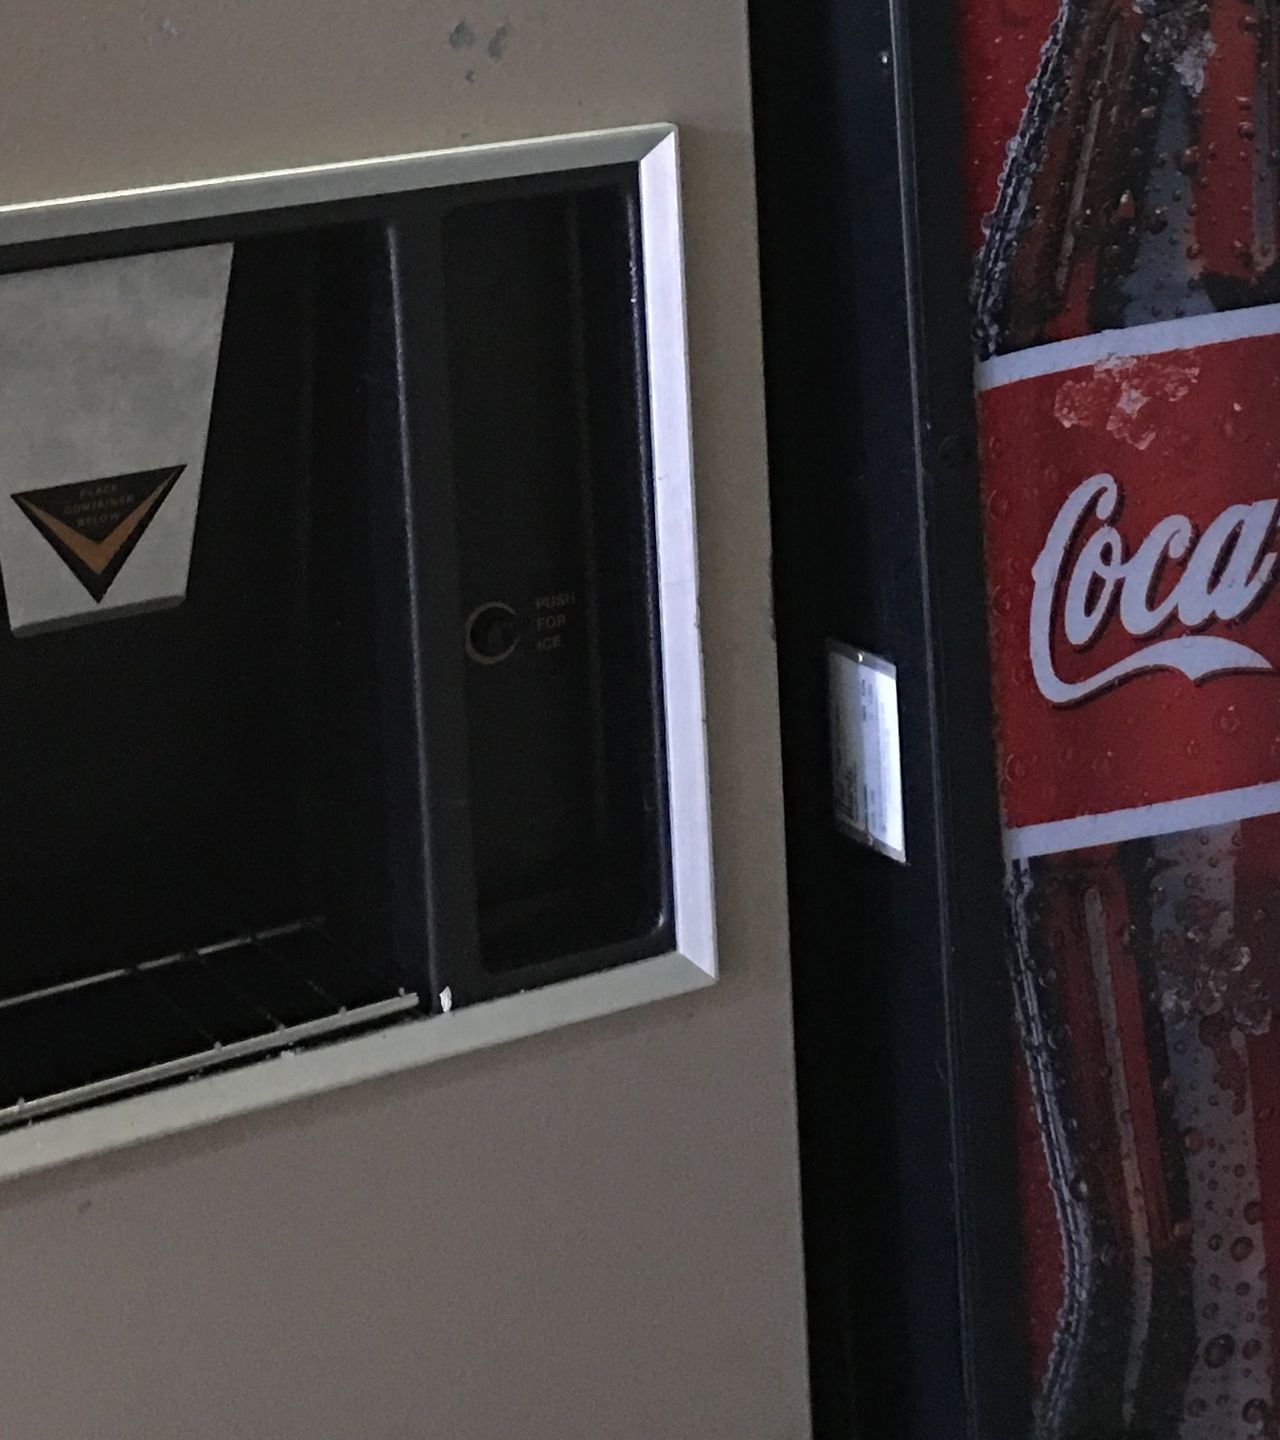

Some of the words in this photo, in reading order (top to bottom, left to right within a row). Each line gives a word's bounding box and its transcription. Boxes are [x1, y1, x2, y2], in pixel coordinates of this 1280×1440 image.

[79, 481, 119, 497] PLACE
[535, 591, 576, 610] PUSH
[536, 614, 567, 632] FOR
[536, 634, 562, 651] ICE
